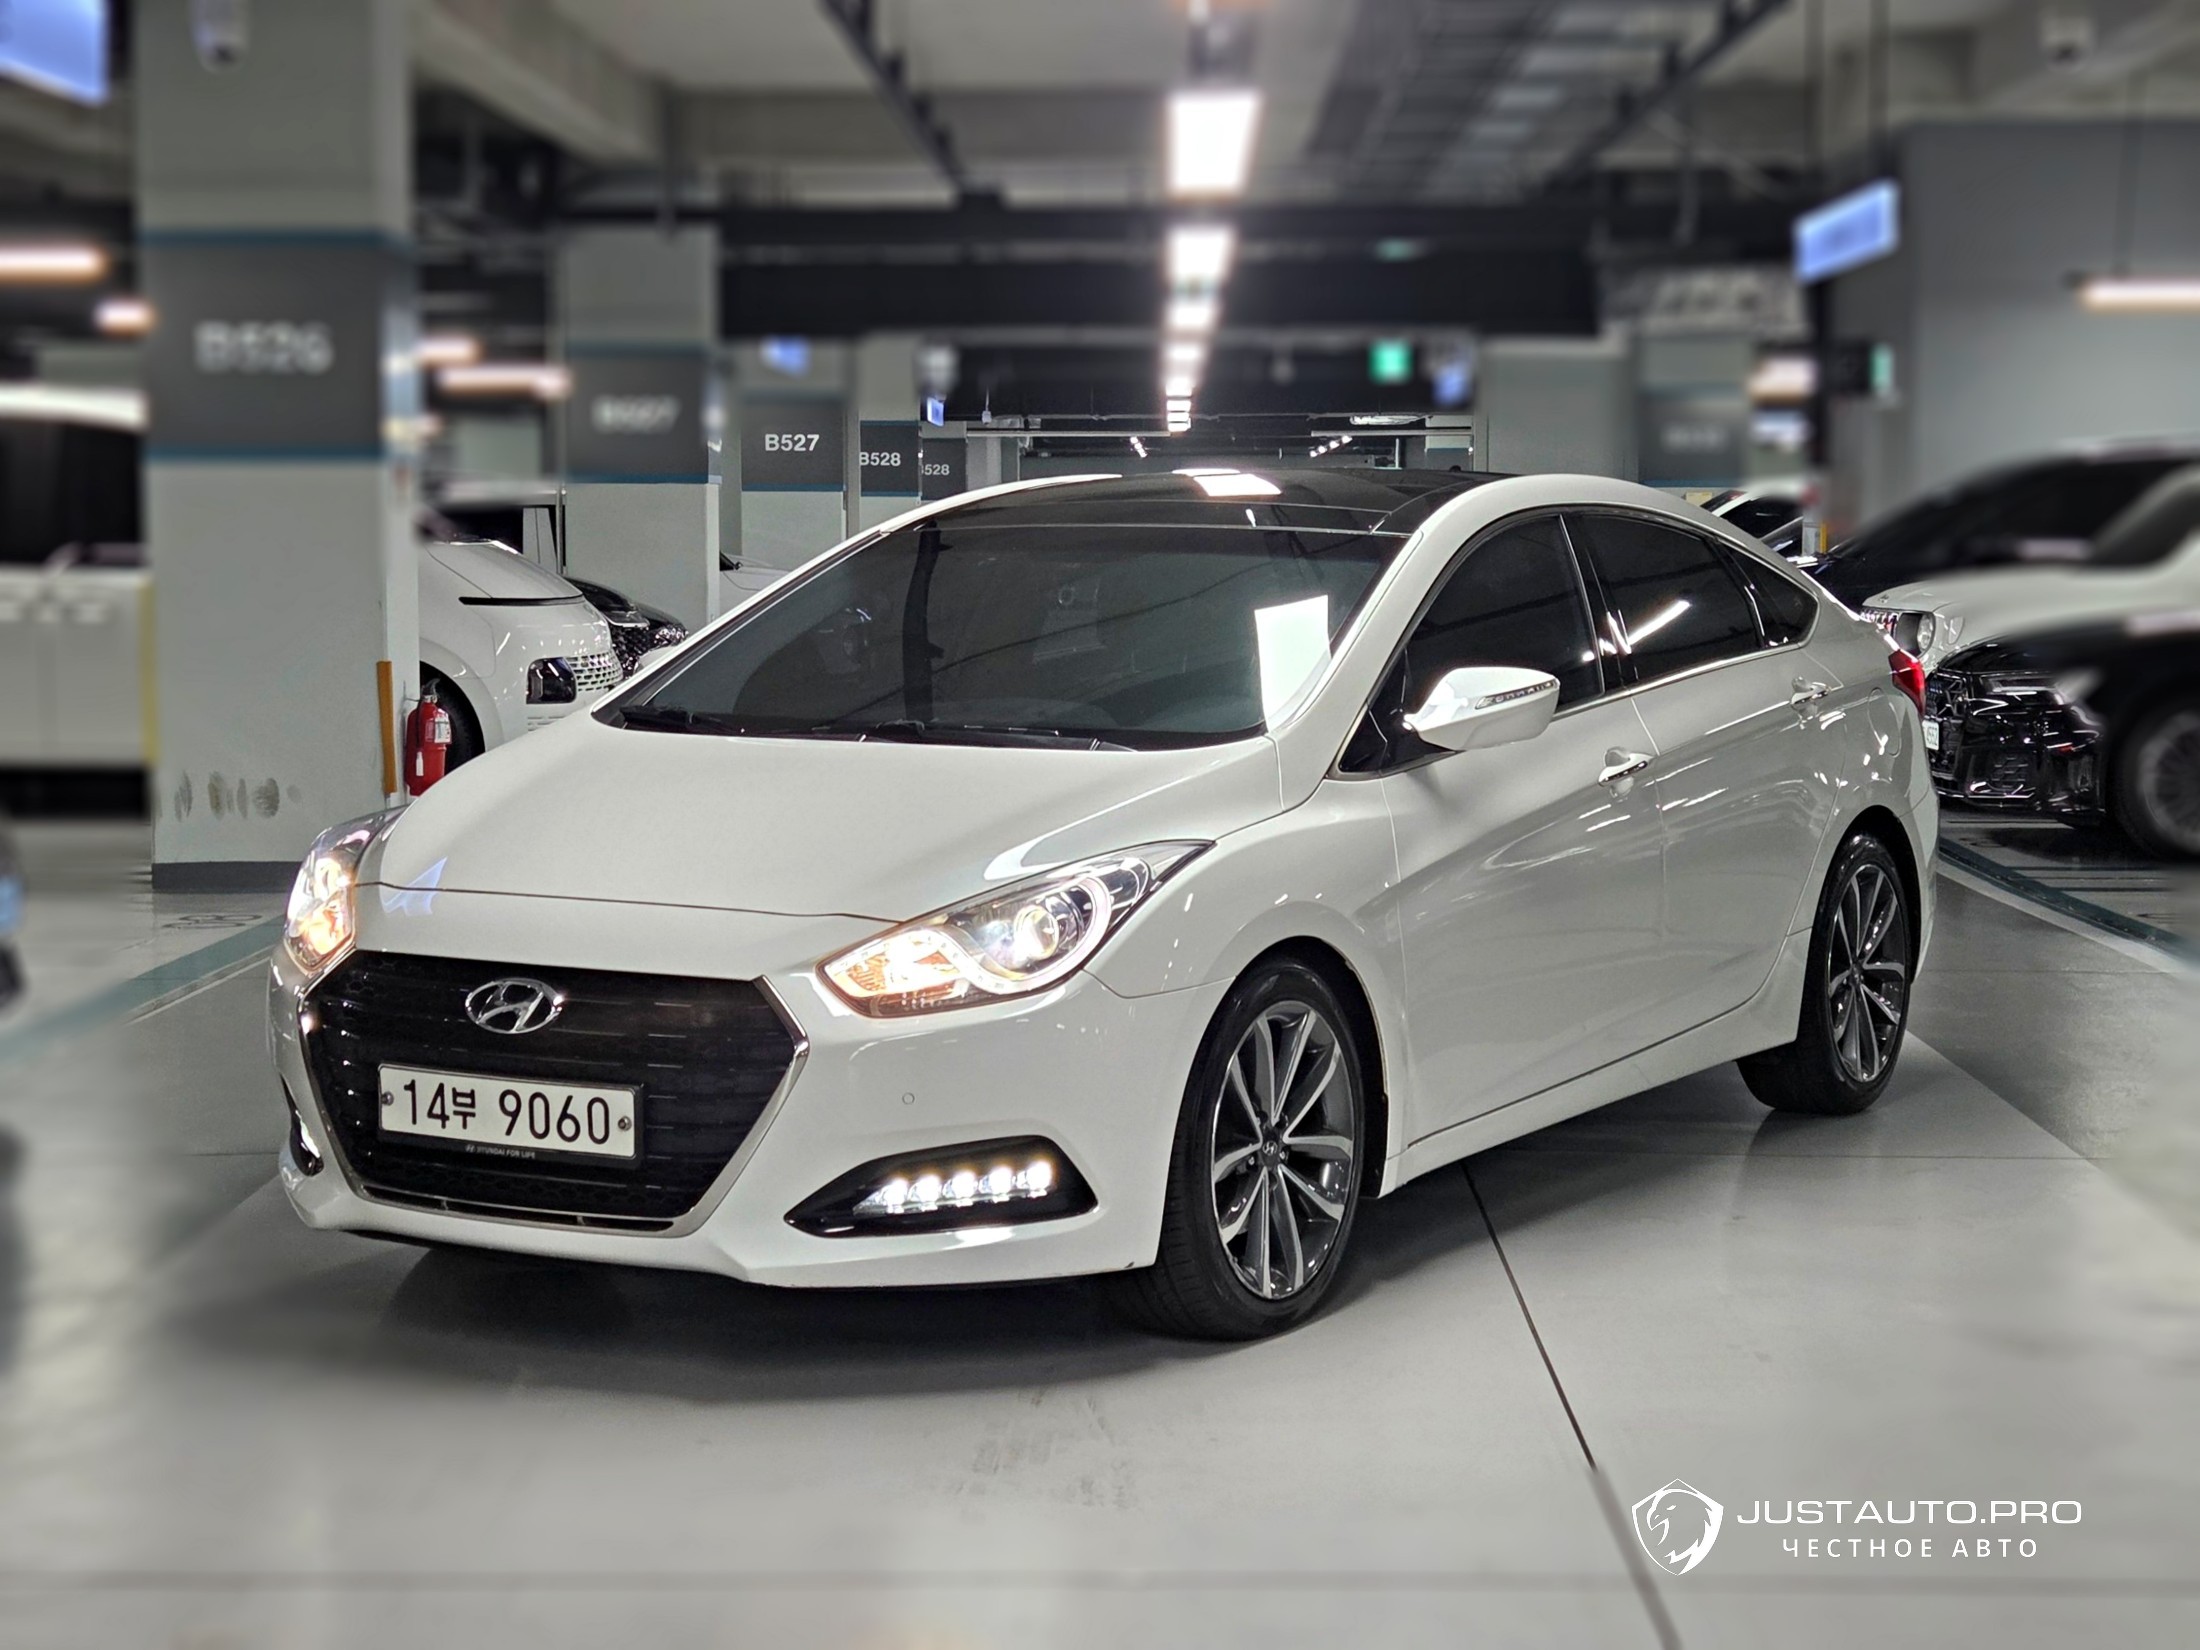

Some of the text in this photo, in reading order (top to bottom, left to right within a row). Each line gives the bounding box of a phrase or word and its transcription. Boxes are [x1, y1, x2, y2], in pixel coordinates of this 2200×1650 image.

[765, 433, 820, 452] B527
[859, 452, 901, 467] B528
[921, 464, 950, 476] 528
[403, 1079, 610, 1145] 14부 9060
[506, 1149, 520, 1157] FOR
